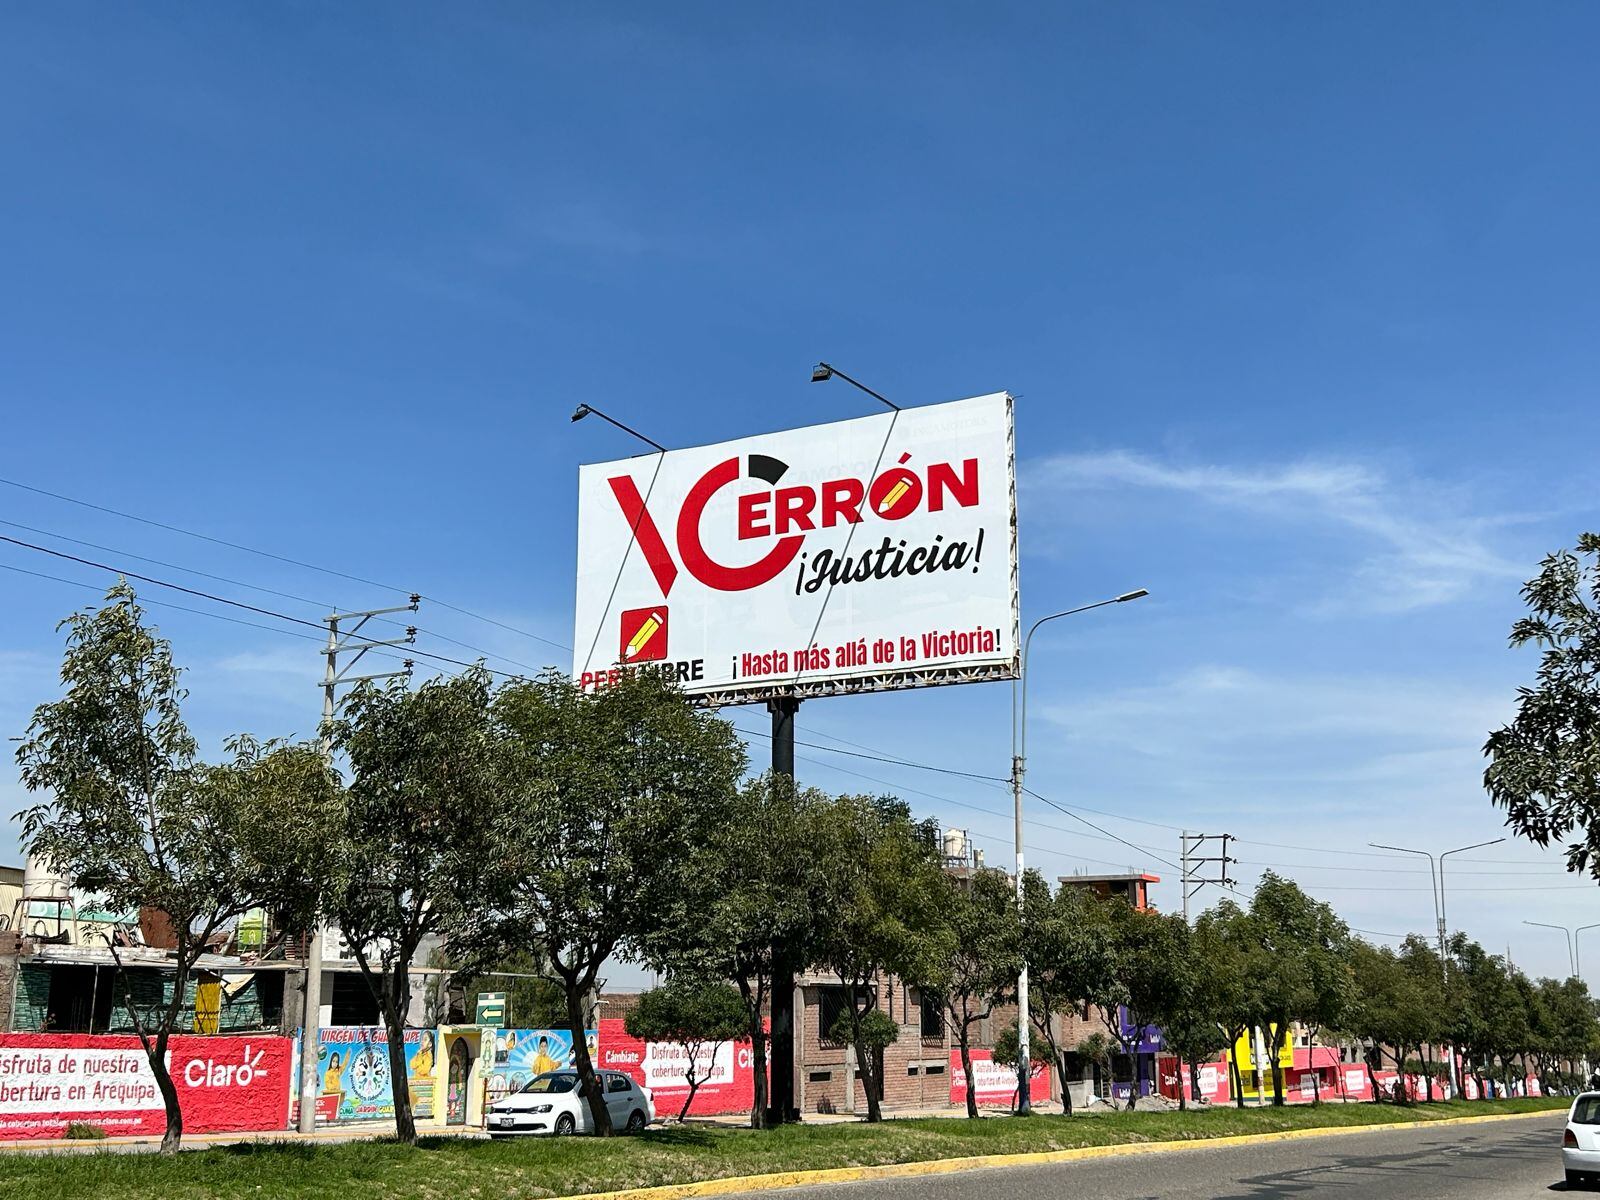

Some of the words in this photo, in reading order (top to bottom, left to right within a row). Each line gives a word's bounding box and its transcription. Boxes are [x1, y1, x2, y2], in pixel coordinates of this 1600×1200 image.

[796, 528, 984, 595] ¡Justicia!
[742, 650, 788, 677] Hasta
[794, 642, 830, 672] más
[836, 637, 867, 668] allá
[873, 638, 895, 663] de
[901, 636, 916, 661] la
[921, 625, 1001, 659] Victoria!
[581, 669, 637, 690] PER
[321, 1030, 355, 1044] VIRGEN
[357, 1030, 369, 1044] DE
[652, 1046, 679, 1060] Disfruta
[58, 1054, 77, 1073] de
[83, 1055, 139, 1074] nuestra
[184, 1059, 253, 1087] Claro
[652, 1064, 685, 1078] cobertura
[697, 1064, 725, 1079] Areuipa
[0, 1081, 61, 1102] bertura
[68, 1085, 86, 1099] en
[93, 1081, 156, 1105] Arequipa
